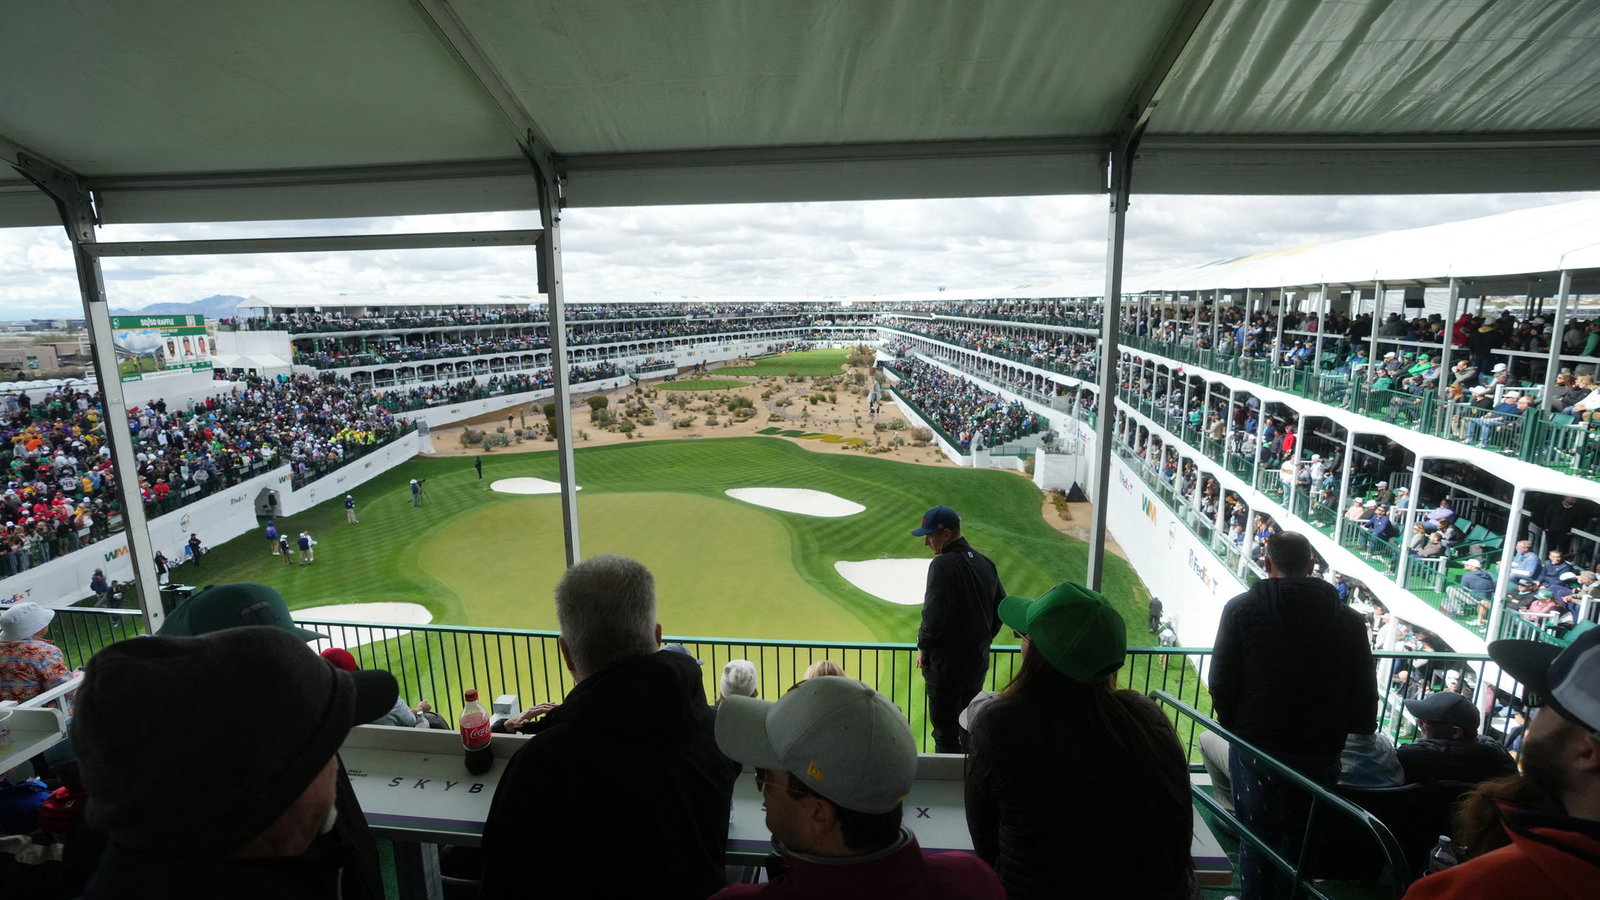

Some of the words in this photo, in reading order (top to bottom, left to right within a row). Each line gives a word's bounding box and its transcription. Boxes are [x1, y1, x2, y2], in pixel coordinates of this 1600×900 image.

[157, 318, 175, 326] RAFFLE
[1142, 493, 1156, 525] WM
[104, 545, 128, 562] WM
[1194, 556, 1211, 588] FedEx
